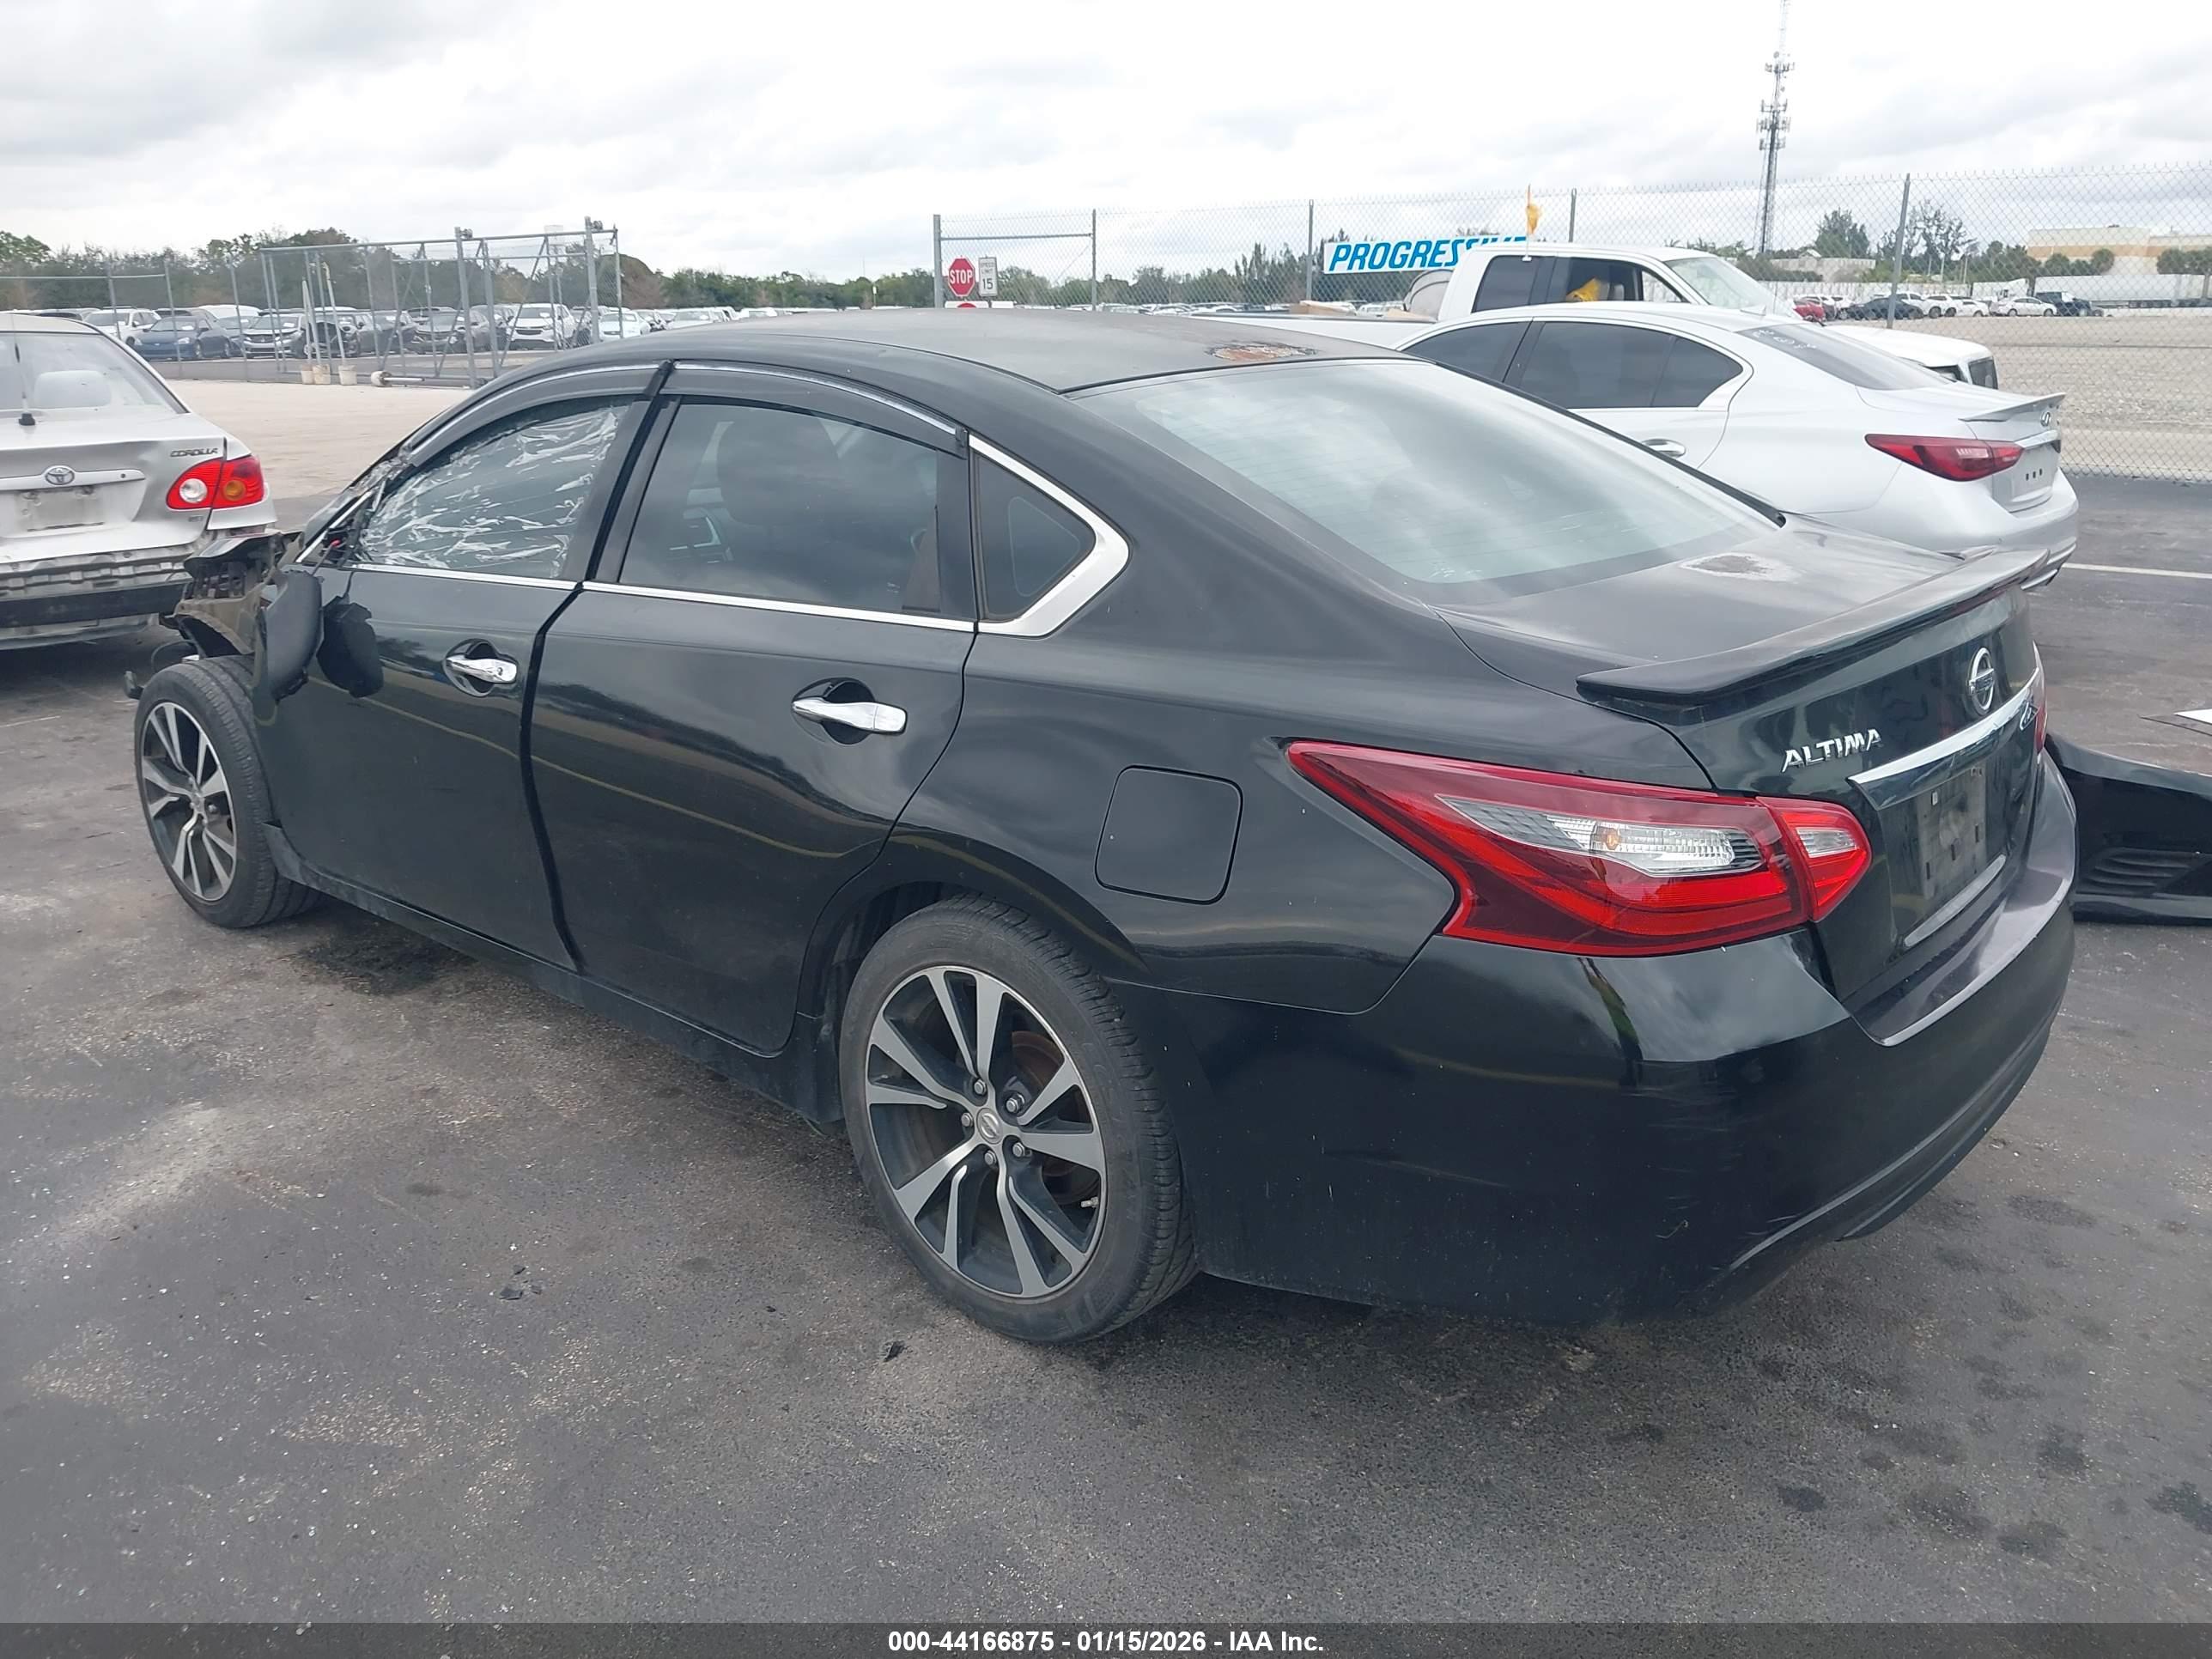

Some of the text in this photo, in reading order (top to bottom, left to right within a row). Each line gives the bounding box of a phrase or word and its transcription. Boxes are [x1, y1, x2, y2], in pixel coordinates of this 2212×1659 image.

[1329, 236, 1526, 271] PROGRES
[950, 270, 973, 284] STOP
[982, 278, 994, 289] 15
[1782, 728, 1883, 773] ALTIMA
